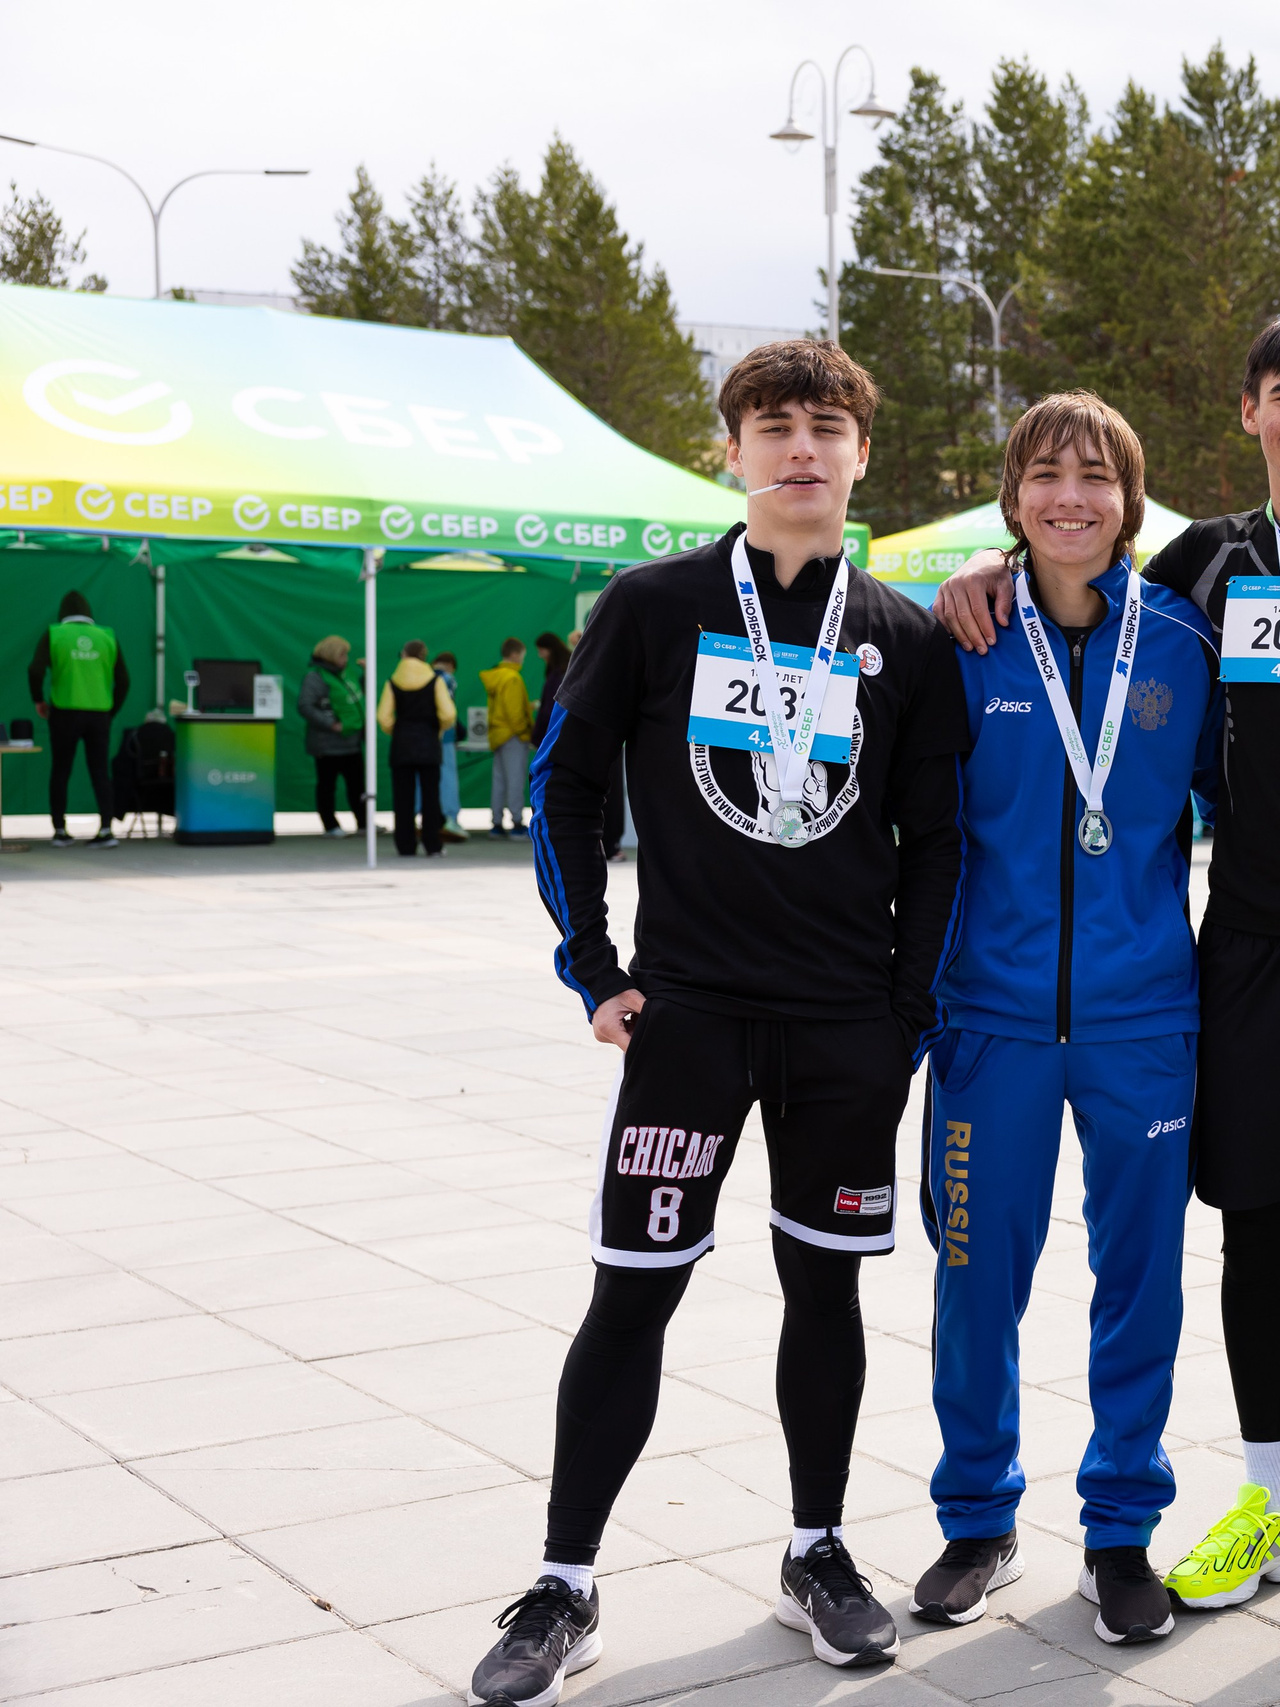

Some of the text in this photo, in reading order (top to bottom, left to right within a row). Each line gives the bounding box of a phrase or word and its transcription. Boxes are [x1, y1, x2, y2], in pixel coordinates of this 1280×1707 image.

[231, 386, 563, 464] СБЕР
[123, 492, 213, 521] СБЕР
[278, 503, 362, 531] СБЕР
[421, 513, 498, 539] СБЕР
[554, 522, 627, 548] СБЕР
[743, 597, 767, 662] НОЯБРЬСК
[825, 588, 845, 645] НОЯБРЬСК
[1122, 597, 1138, 658] НОЯБРЬСК
[1027, 620, 1056, 682] НОЯБРЬСК
[782, 673, 803, 684] ЛЕТ
[1000, 701, 1033, 713] asics
[800, 708, 814, 739] СБЕР
[1102, 720, 1114, 751] СБЕР
[712, 795, 757, 833] МЕСТНАЯ
[1162, 1116, 1187, 1133] asics
[944, 1120, 972, 1267] RUSSIA
[647, 1186, 684, 1242] 8
